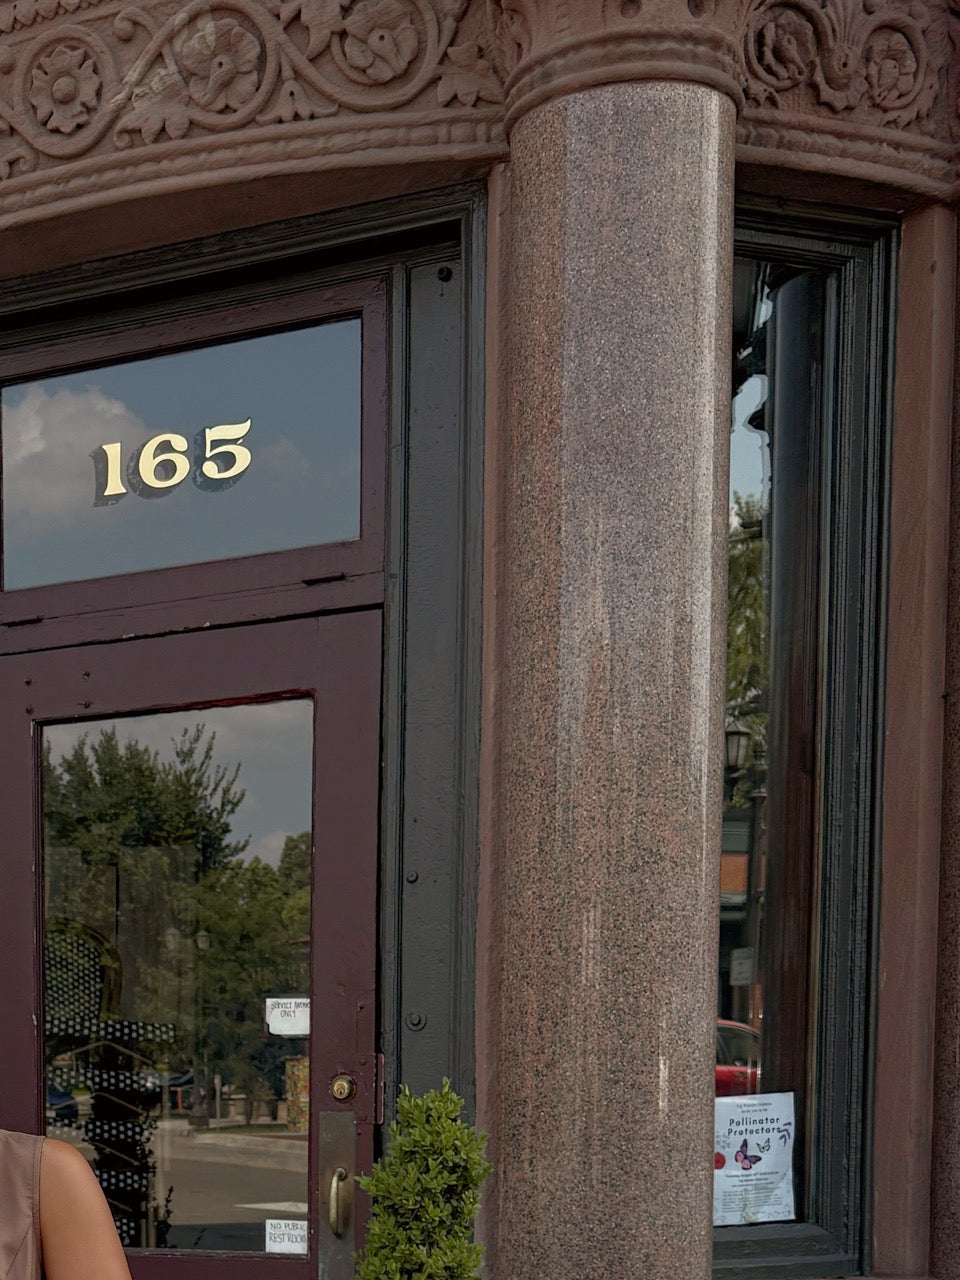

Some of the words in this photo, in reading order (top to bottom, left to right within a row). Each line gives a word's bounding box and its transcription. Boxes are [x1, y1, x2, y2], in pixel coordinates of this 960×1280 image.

[100, 416, 253, 498] 165
[280, 1010, 296, 1018] ONLY
[729, 1117, 780, 1127] Pollinator
[727, 1127, 782, 1136] Protectors
[270, 1222, 282, 1230] NO
[284, 1222, 306, 1231] PUBLIC
